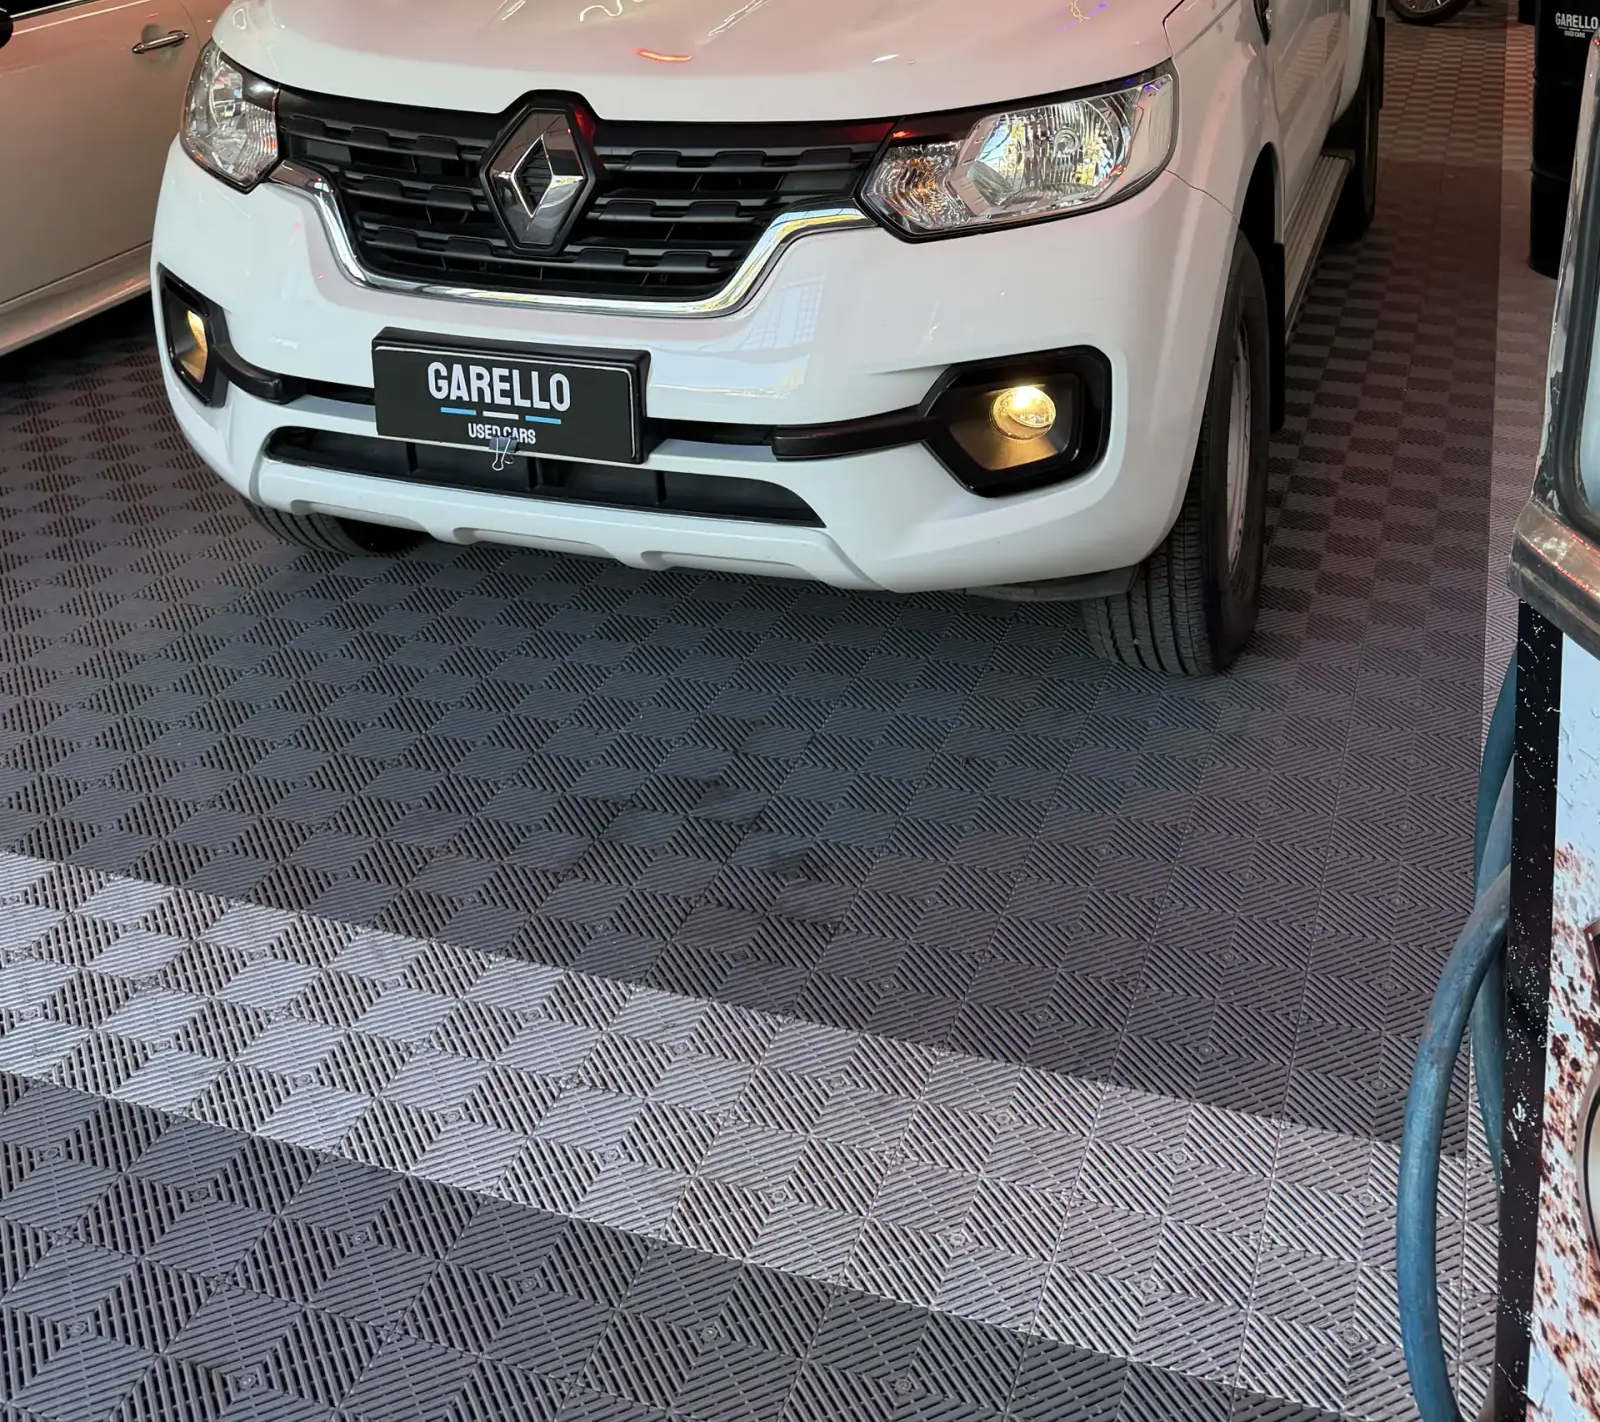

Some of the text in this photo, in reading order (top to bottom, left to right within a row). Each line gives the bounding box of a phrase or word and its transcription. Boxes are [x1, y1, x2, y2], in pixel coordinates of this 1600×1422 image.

[1555, 12, 1598, 30] GARELLO
[427, 361, 571, 412] GARELLO
[468, 423, 536, 444] USED CARS
